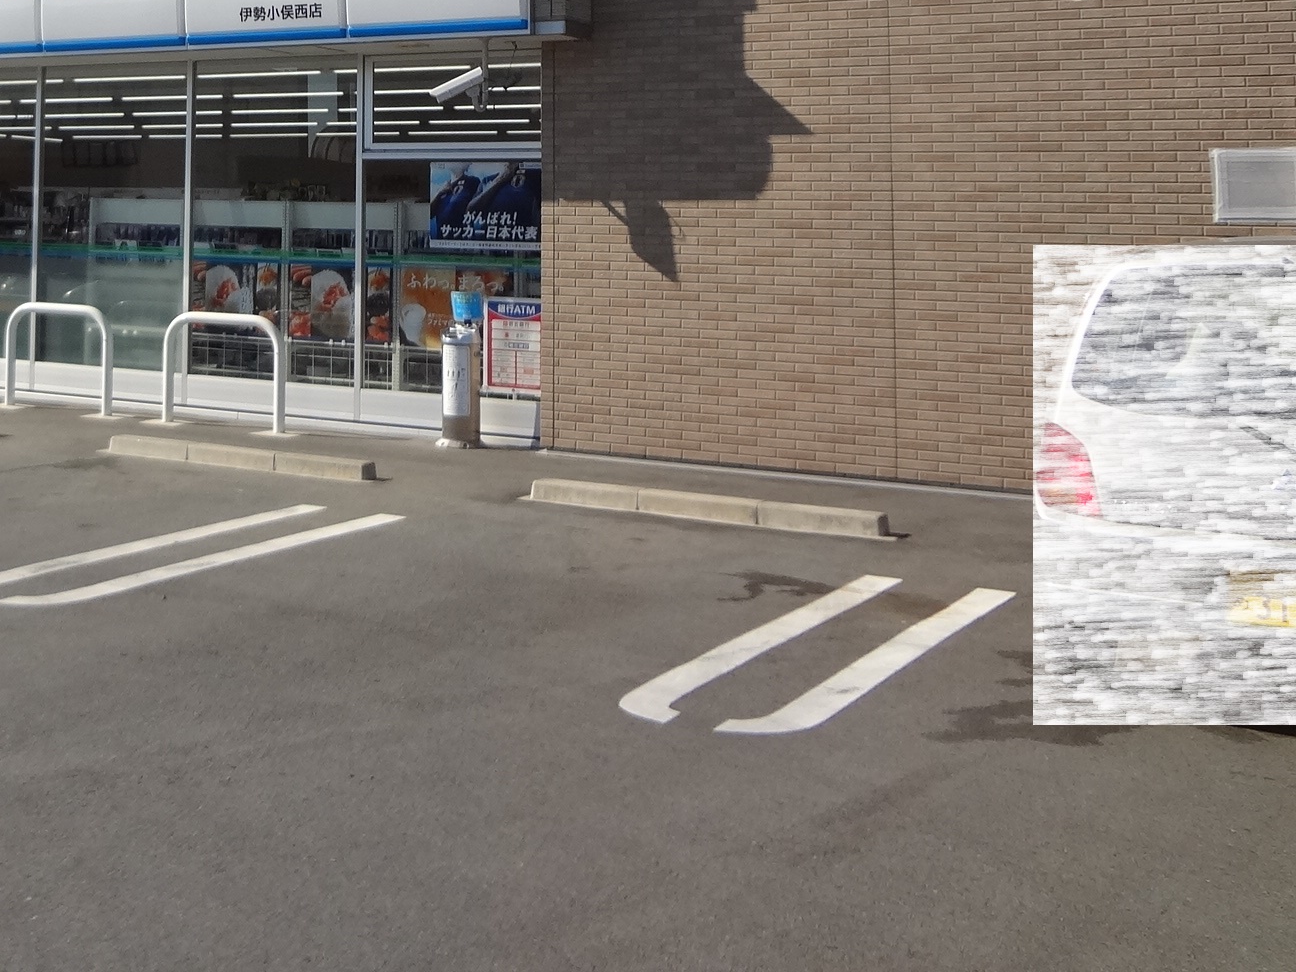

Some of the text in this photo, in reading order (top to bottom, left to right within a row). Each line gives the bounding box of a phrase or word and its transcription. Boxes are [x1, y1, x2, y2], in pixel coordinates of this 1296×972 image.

[239, 3, 322, 22] 伊勢小俣西店
[440, 224, 538, 240] サッカー日本代表
